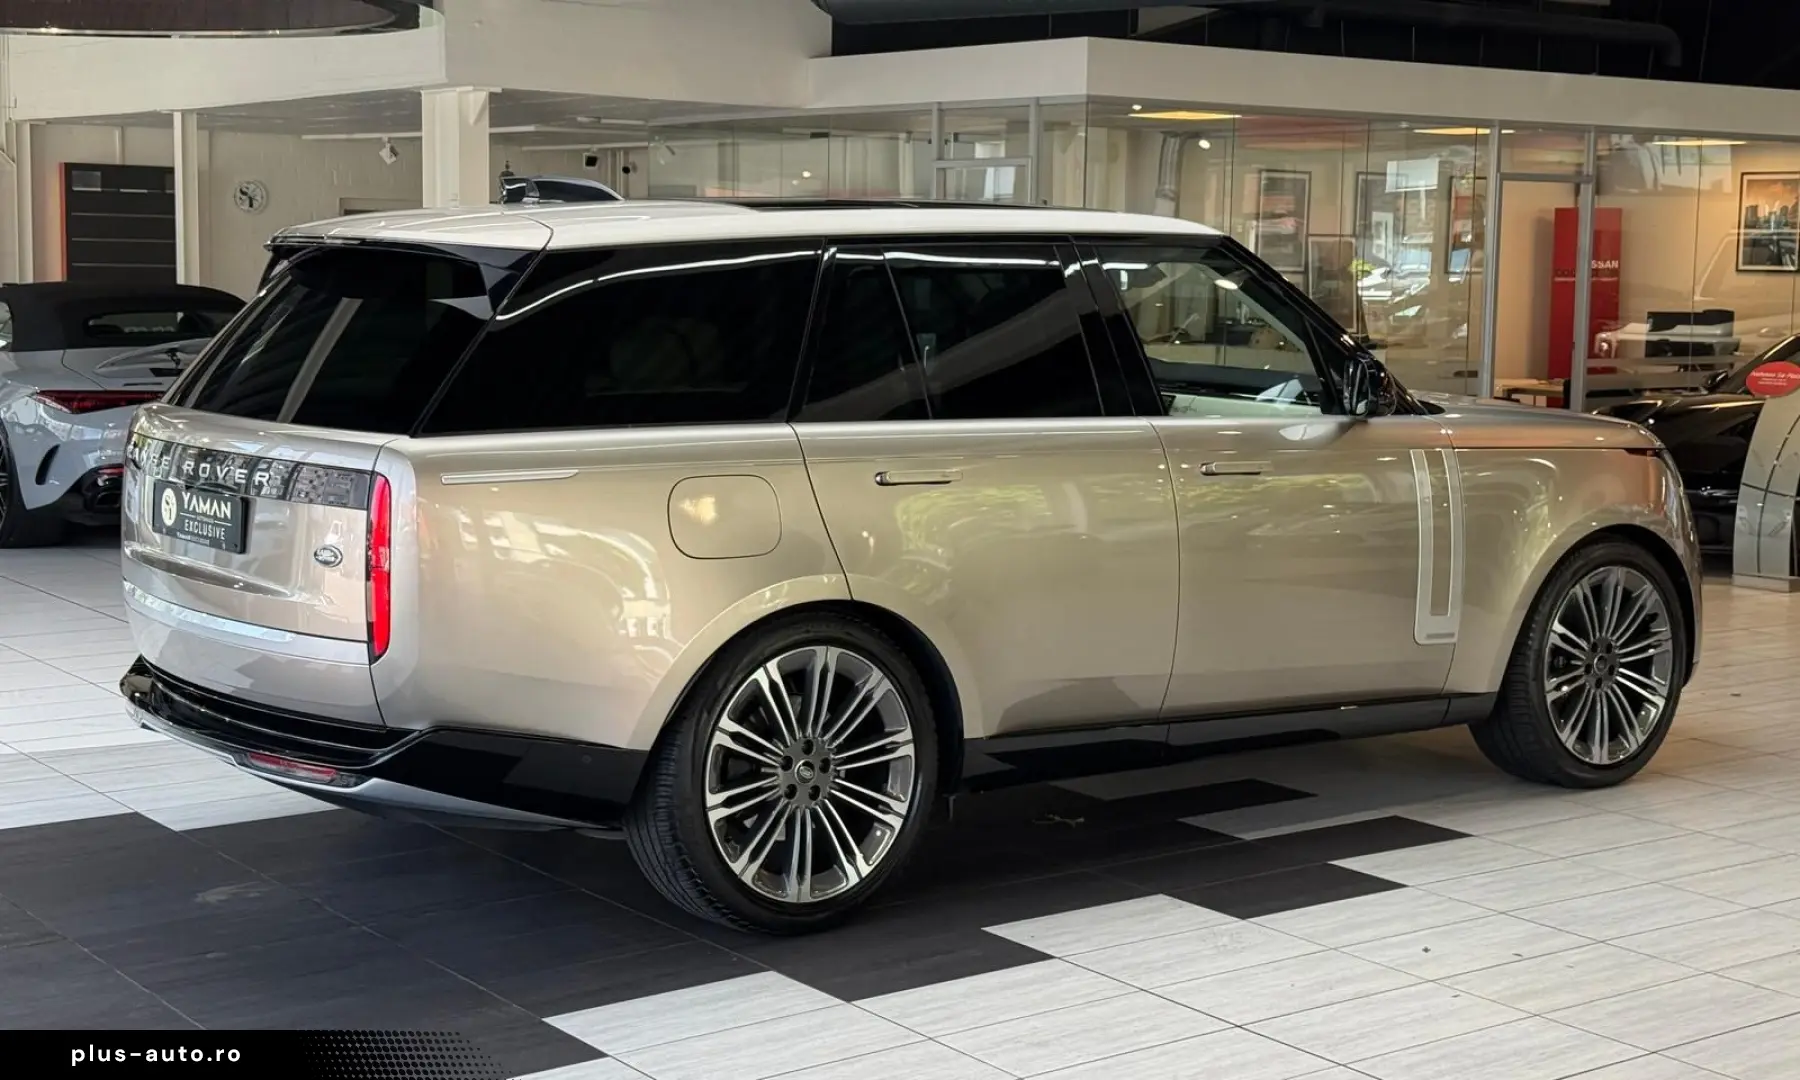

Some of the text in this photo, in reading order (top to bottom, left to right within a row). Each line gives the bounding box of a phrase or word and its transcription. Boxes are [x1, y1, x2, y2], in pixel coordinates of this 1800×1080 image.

[1591, 260, 1619, 269] SSAN
[183, 460, 270, 487] ROVER
[182, 491, 231, 520] YAMAN
[184, 519, 226, 541] EXCLUSIVE
